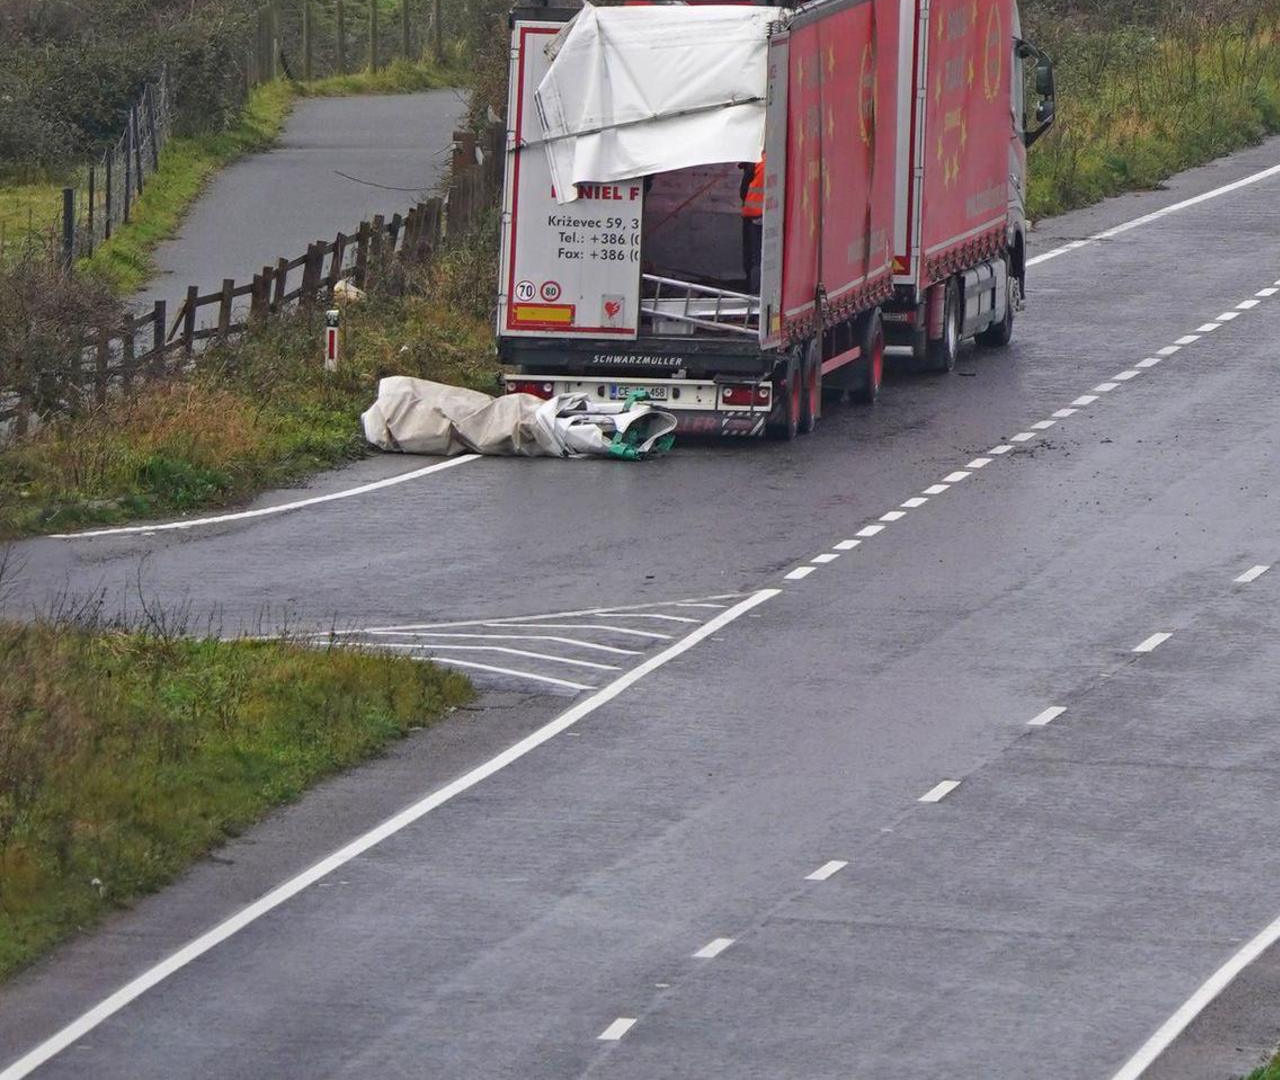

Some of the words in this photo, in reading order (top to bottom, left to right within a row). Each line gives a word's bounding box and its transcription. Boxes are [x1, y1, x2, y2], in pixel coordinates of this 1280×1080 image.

[551, 185, 622, 201] NIEL
[548, 215, 602, 229] Križevec
[606, 217, 626, 230] 59,
[559, 232, 585, 244] Tel.:
[590, 233, 626, 245] +386
[558, 248, 584, 259] Fax:
[590, 249, 625, 261] +386
[519, 285, 533, 298] 70
[544, 286, 556, 297] 80
[618, 386, 629, 397] CE
